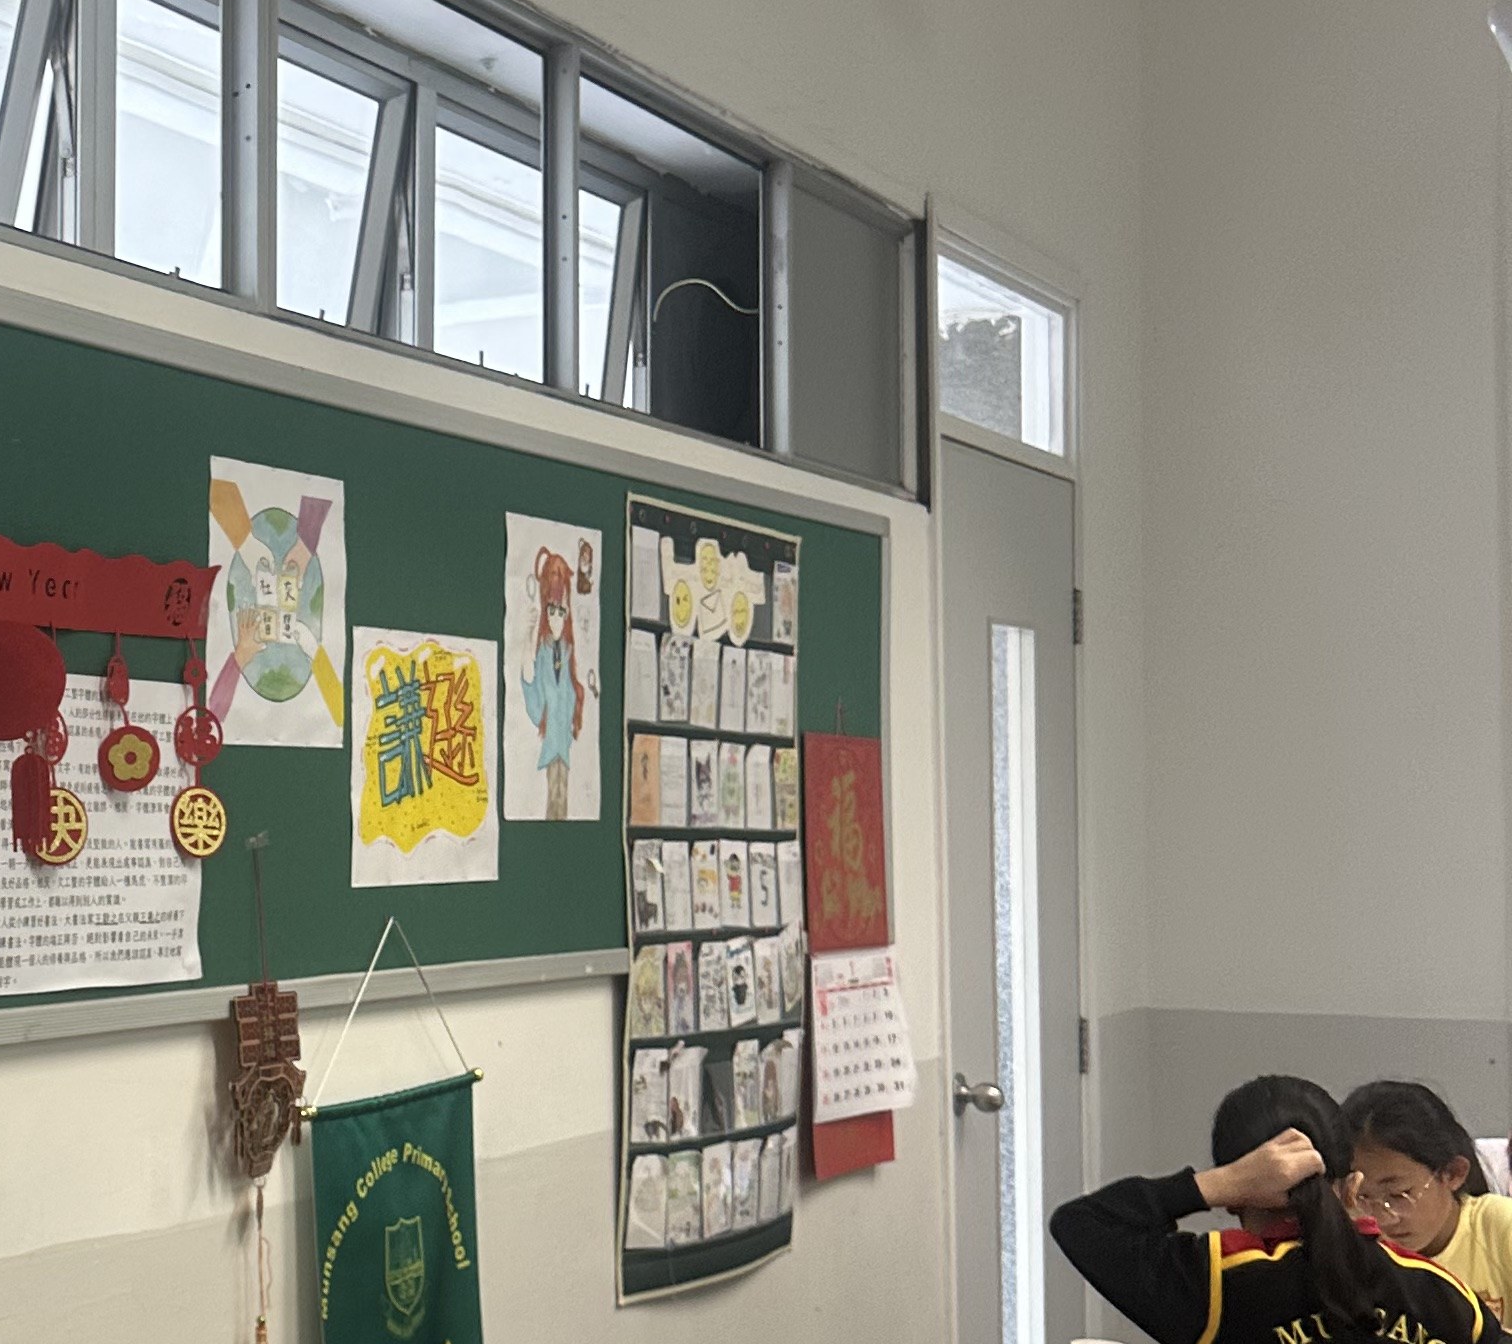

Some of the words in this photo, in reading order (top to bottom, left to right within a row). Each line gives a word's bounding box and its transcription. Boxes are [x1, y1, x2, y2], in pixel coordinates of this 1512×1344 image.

[375, 659, 479, 807] 謙遜
[178, 795, 221, 855] 樂
[356, 1148, 399, 1199] College
